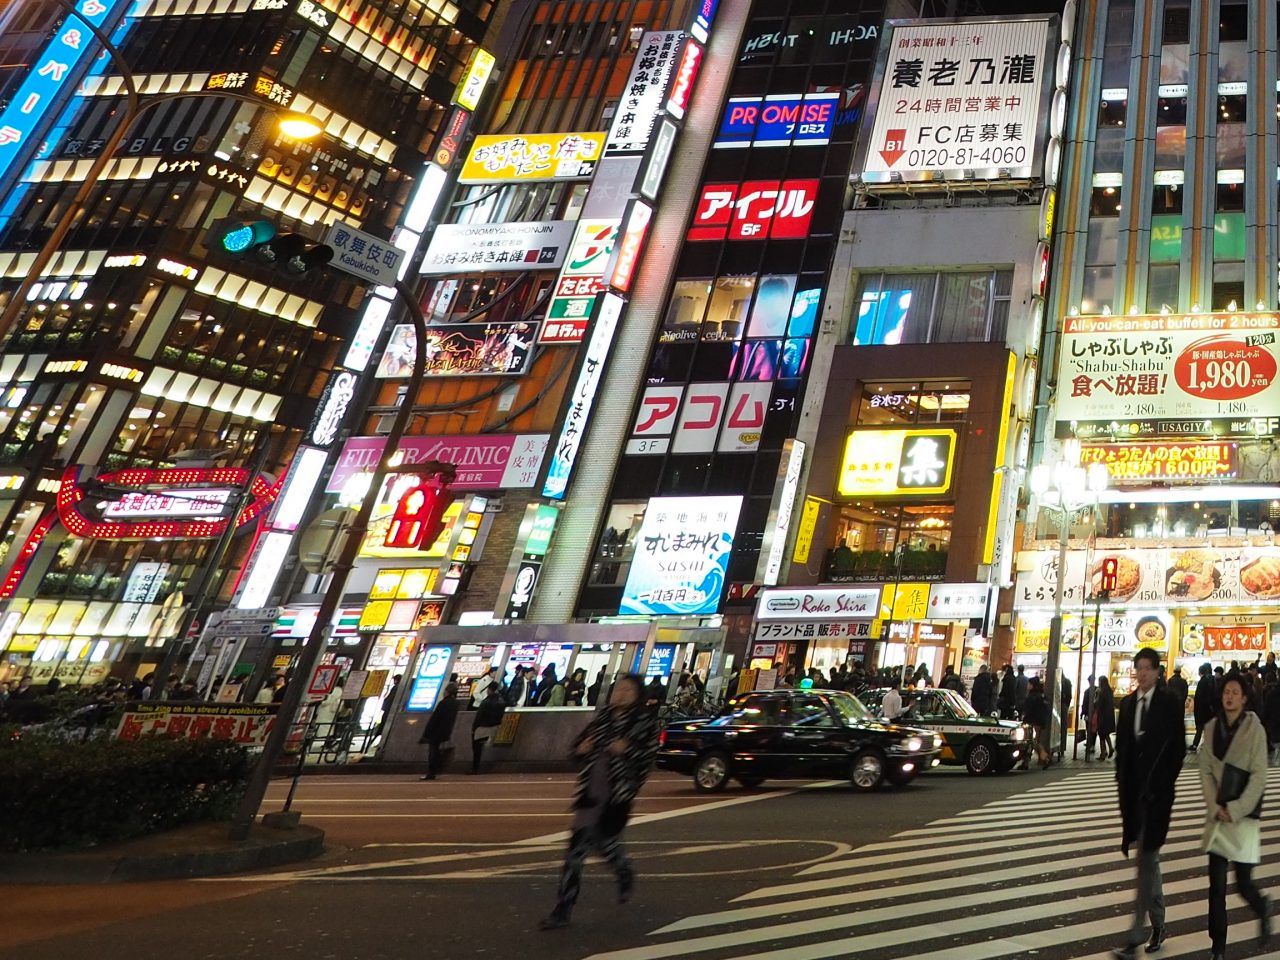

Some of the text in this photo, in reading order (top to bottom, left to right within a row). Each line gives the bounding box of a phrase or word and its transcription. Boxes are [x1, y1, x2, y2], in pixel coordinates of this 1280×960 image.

[62, 28, 81, 50] &
[899, 35, 983, 48] 創業昭和十三年
[892, 54, 1035, 88] 養老乃瀧
[616, 45, 659, 138] お好み焼き本陣
[895, 96, 1021, 114] 24時間営業中
[729, 104, 831, 125] PROMISE
[917, 122, 1023, 144] FC店募集
[885, 141, 902, 151] B1
[908, 146, 1026, 167] 0120-81-4060
[701, 189, 815, 219] アイフル
[518, 226, 553, 234] HONJIN
[740, 223, 761, 236] 5F
[334, 229, 399, 269] 歌舞伎町
[432, 249, 524, 264] お好み焼き本陣
[339, 252, 380, 277] Kabukicho
[564, 300, 589, 317] 酒
[1208, 317, 1225, 328] for
[1230, 318, 1238, 327] 2
[1242, 316, 1278, 327] hours
[544, 324, 585, 338] 銀行AT
[1071, 336, 1173, 357] しゃぶしゃぶ
[425, 359, 446, 371] ALSA
[1187, 361, 1268, 392] 1,980 yen
[636, 394, 763, 432] アコム
[1124, 404, 1154, 416] 2,480
[1217, 402, 1246, 414] 1,480
[1253, 418, 1280, 435] 5F
[434, 446, 510, 464] CLINIC
[638, 441, 658, 452] 3F
[520, 472, 534, 482] 3F
[801, 594, 866, 613] Roko Shira
[761, 625, 815, 636] ブランド品
[183, 705, 196, 713] the
